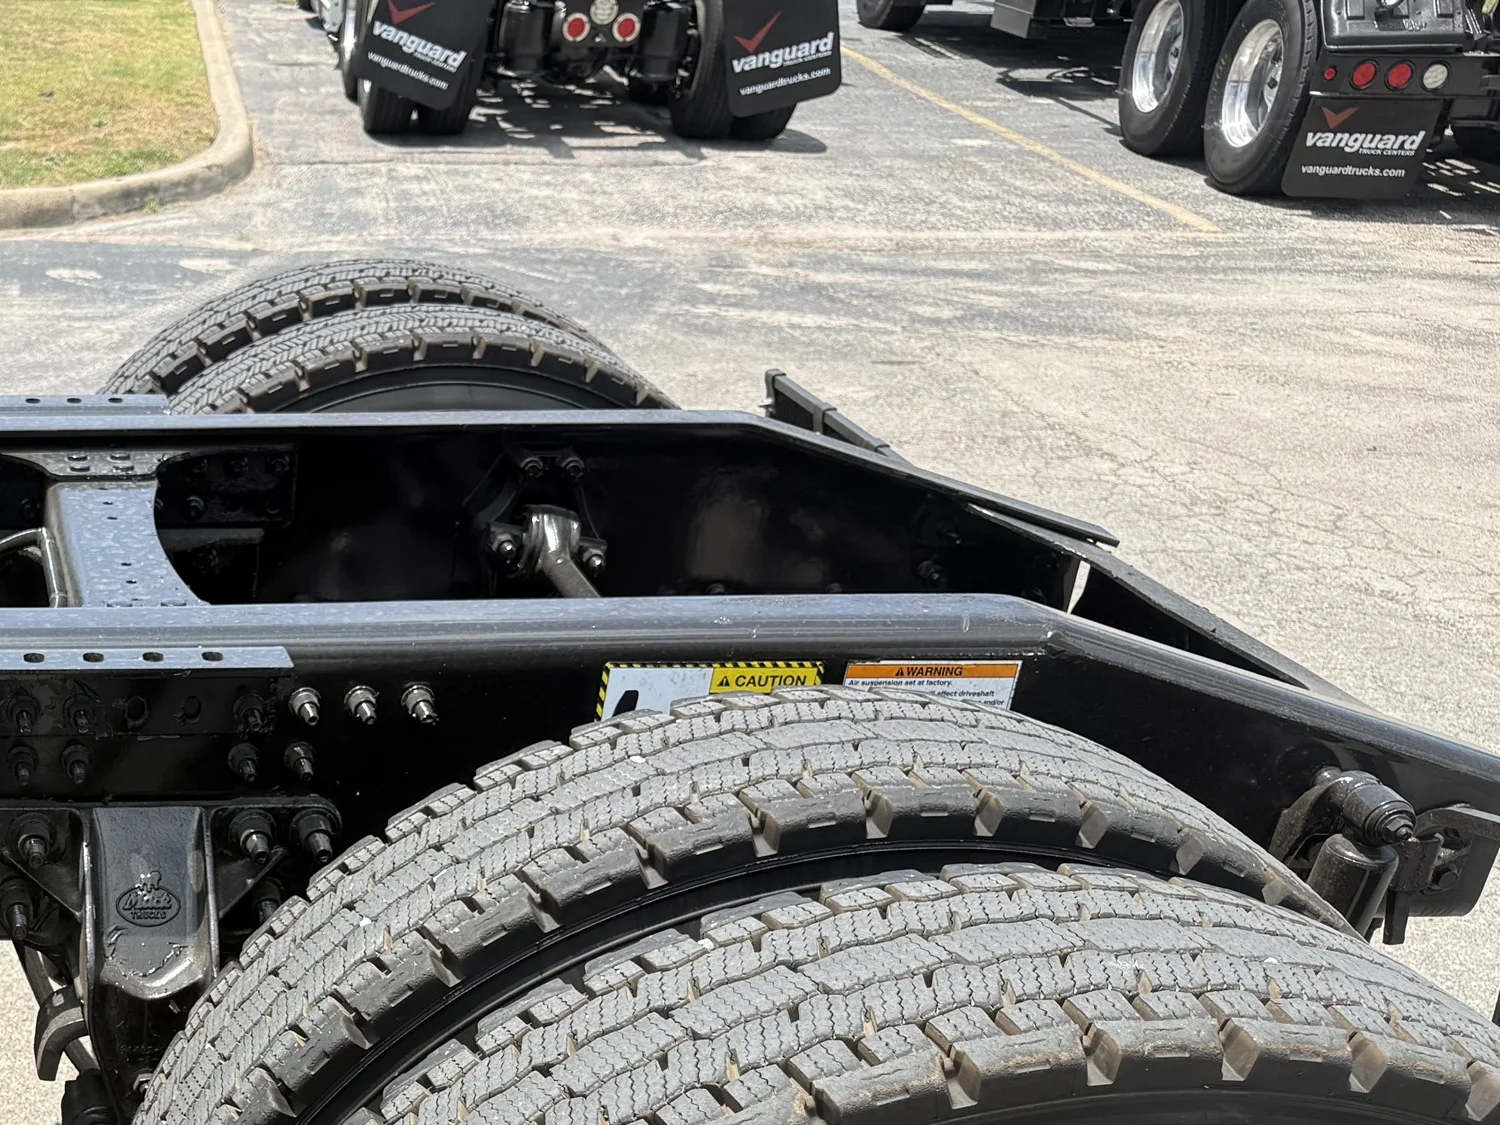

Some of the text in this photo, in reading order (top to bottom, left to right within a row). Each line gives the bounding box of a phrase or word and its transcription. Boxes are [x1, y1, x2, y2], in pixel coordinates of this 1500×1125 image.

[372, 20, 467, 68] vanguard
[732, 31, 835, 73] vanguard
[739, 67, 831, 96] vanguardtrucks.com
[1305, 130, 1426, 152] vanguard
[1301, 164, 1406, 177] vanguardtrucks.com
[906, 667, 964, 677] WARNING
[735, 675, 808, 687] CAUTION
[959, 690, 995, 698] driveshaft
